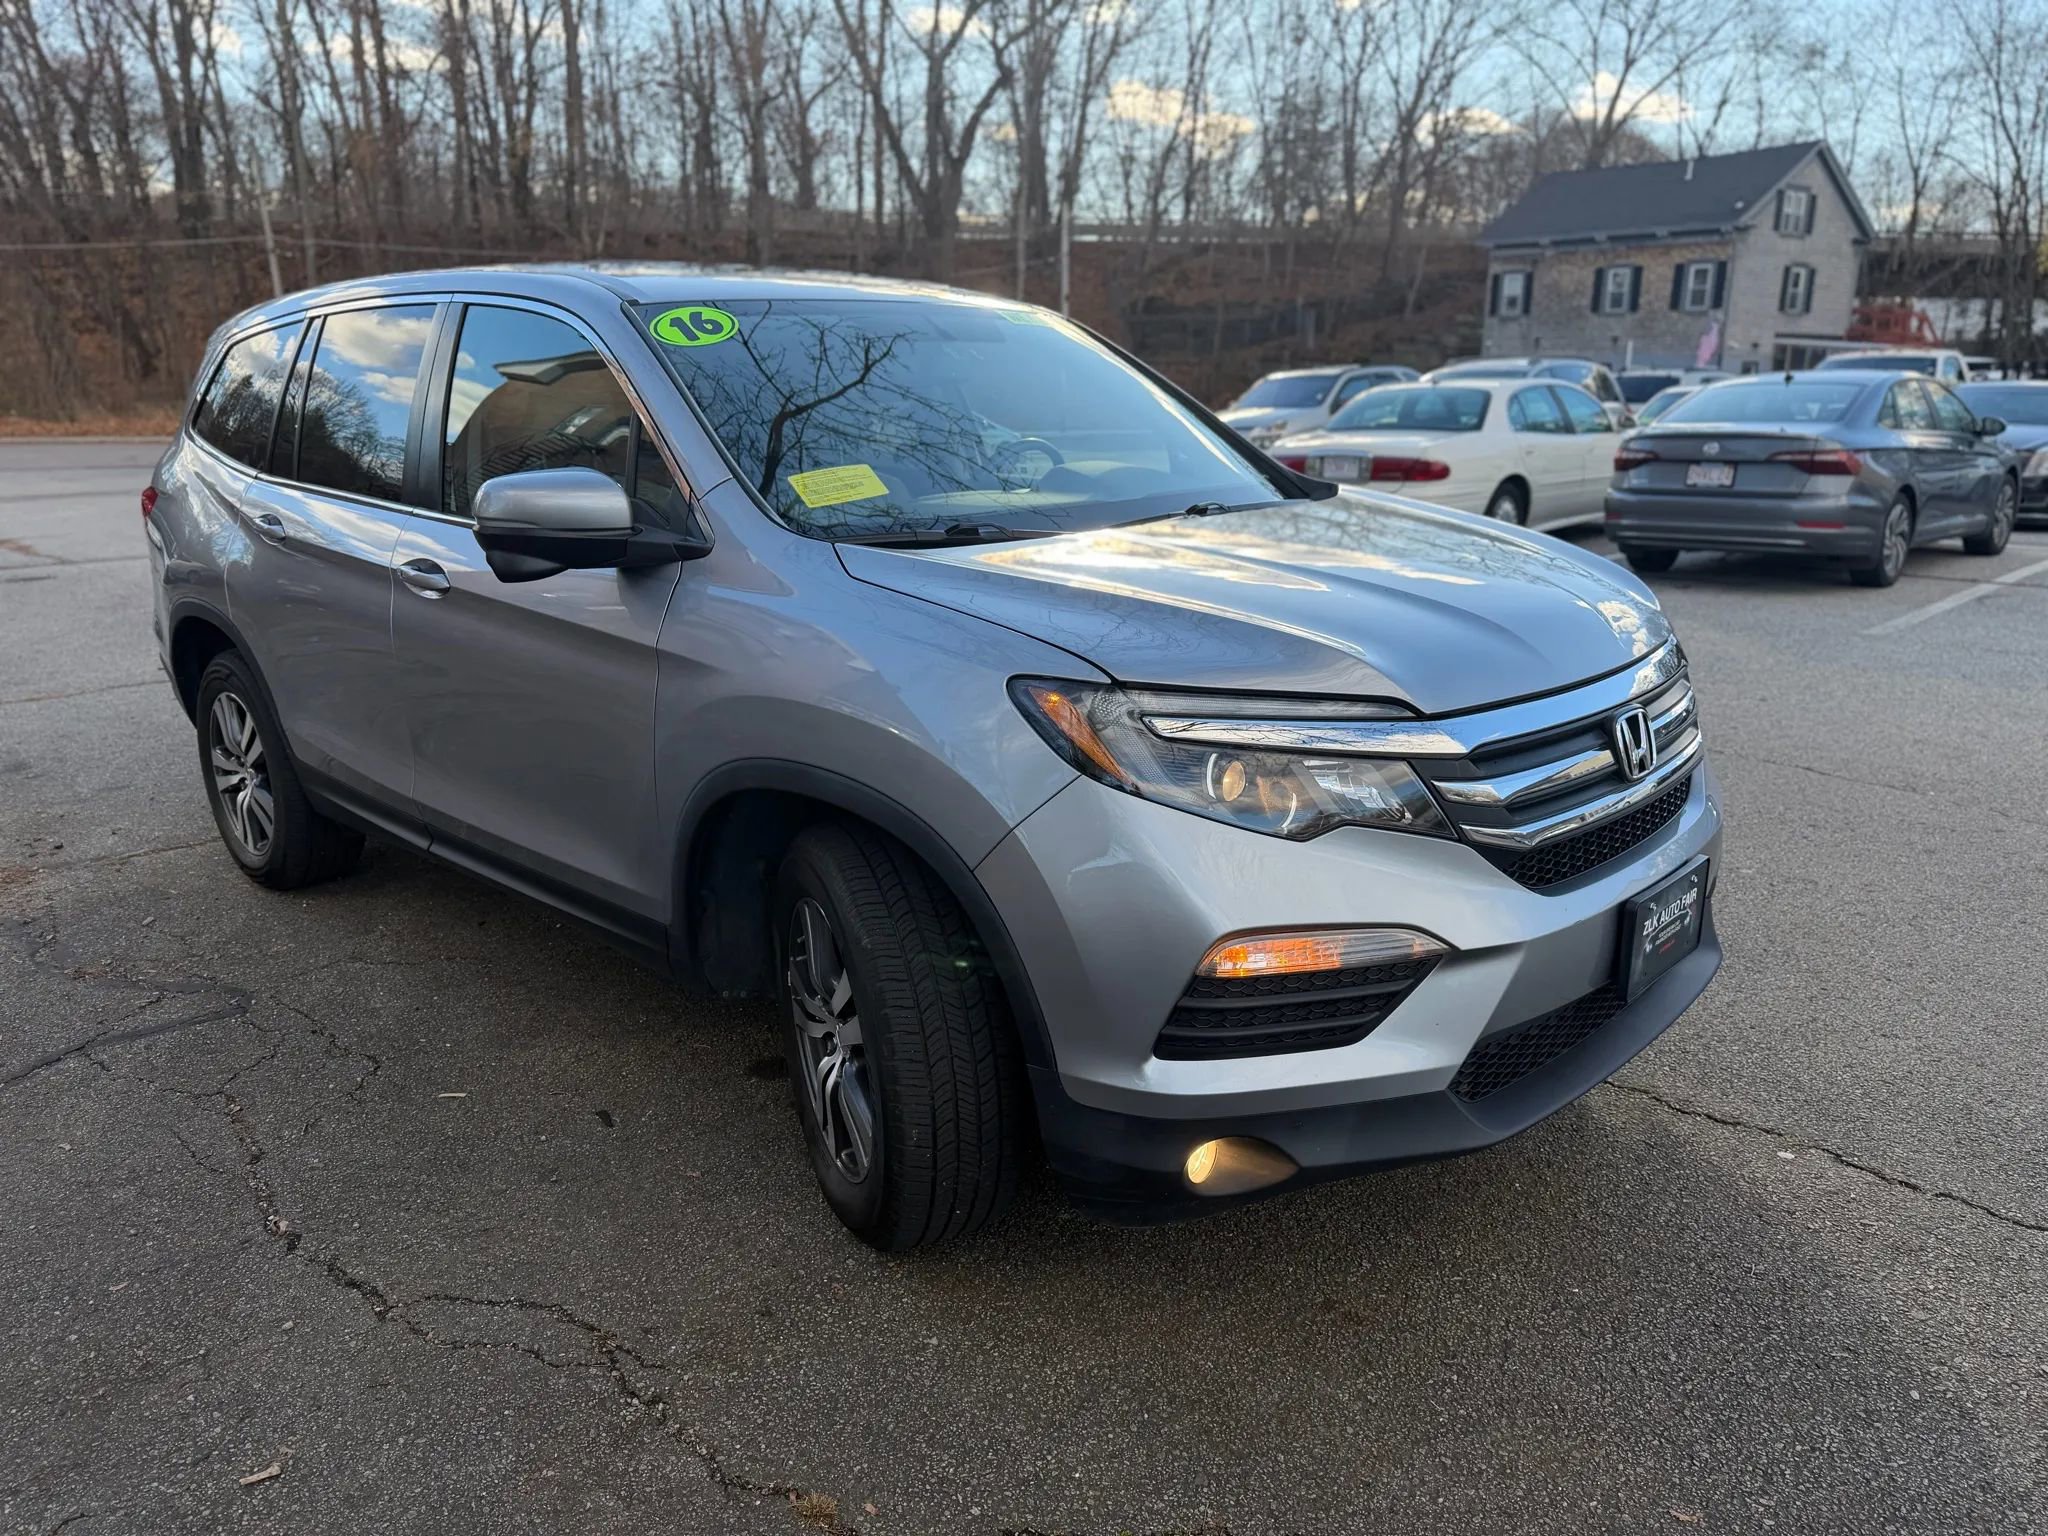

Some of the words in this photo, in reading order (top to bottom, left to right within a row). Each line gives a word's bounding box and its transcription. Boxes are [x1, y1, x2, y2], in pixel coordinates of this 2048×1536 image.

[669, 311, 724, 341] 16
[1642, 912, 1659, 936] ZLK
[1659, 899, 1681, 924] AUTO
[1681, 887, 1698, 909] FAIR
